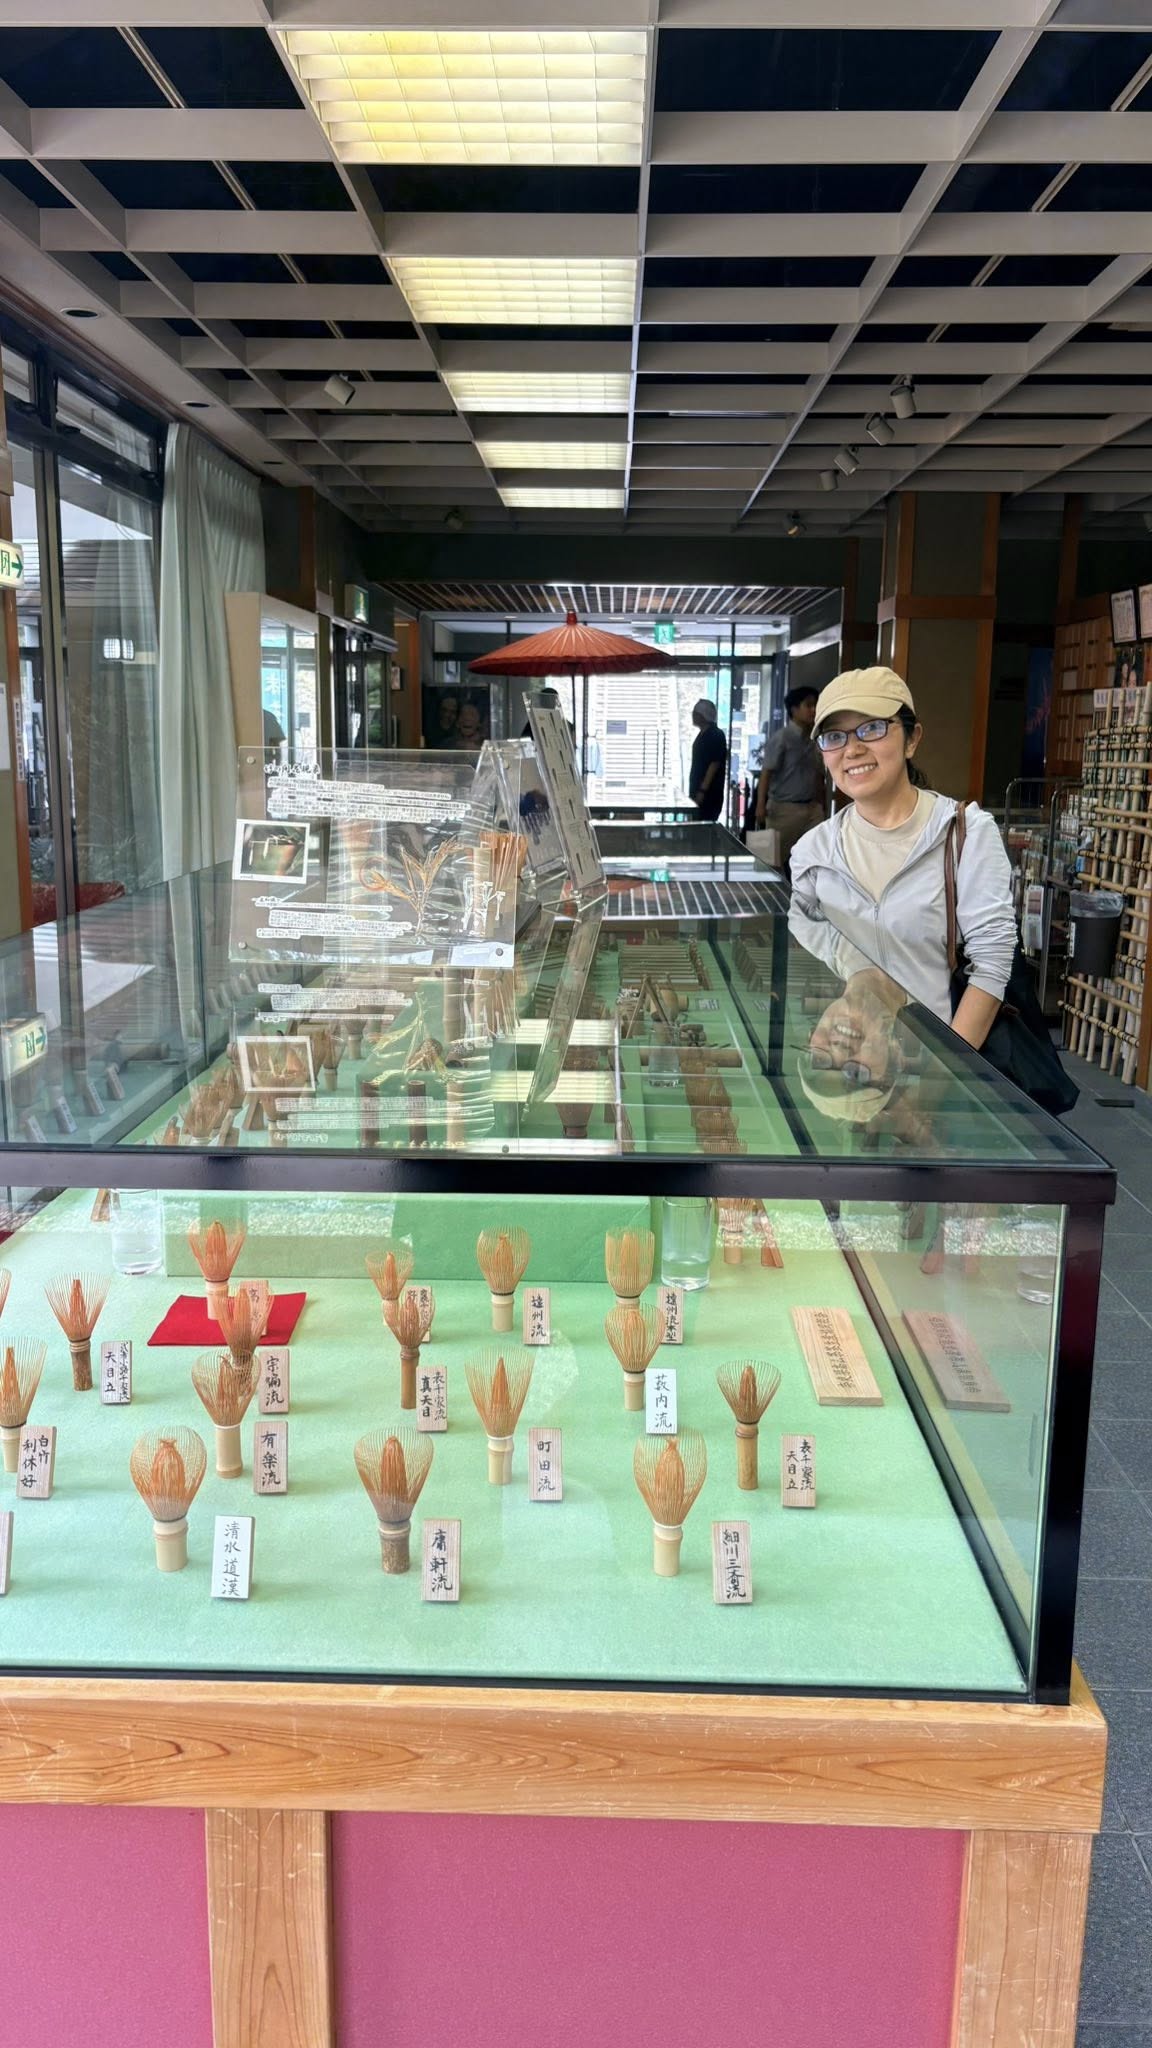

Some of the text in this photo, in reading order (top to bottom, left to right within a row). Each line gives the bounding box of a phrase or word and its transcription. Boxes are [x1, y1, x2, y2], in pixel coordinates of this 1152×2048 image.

[104, 1351, 117, 1393] 天目立
[420, 1376, 433, 1417] 真天目
[21, 1437, 38, 1489] 利休好
[38, 1435, 50, 1465] 白竹
[260, 1431, 280, 1486] 有楽流
[535, 1440, 554, 1494] 町田流
[785, 1451, 799, 1491] 天目立
[800, 1439, 815, 1491] 表千家流
